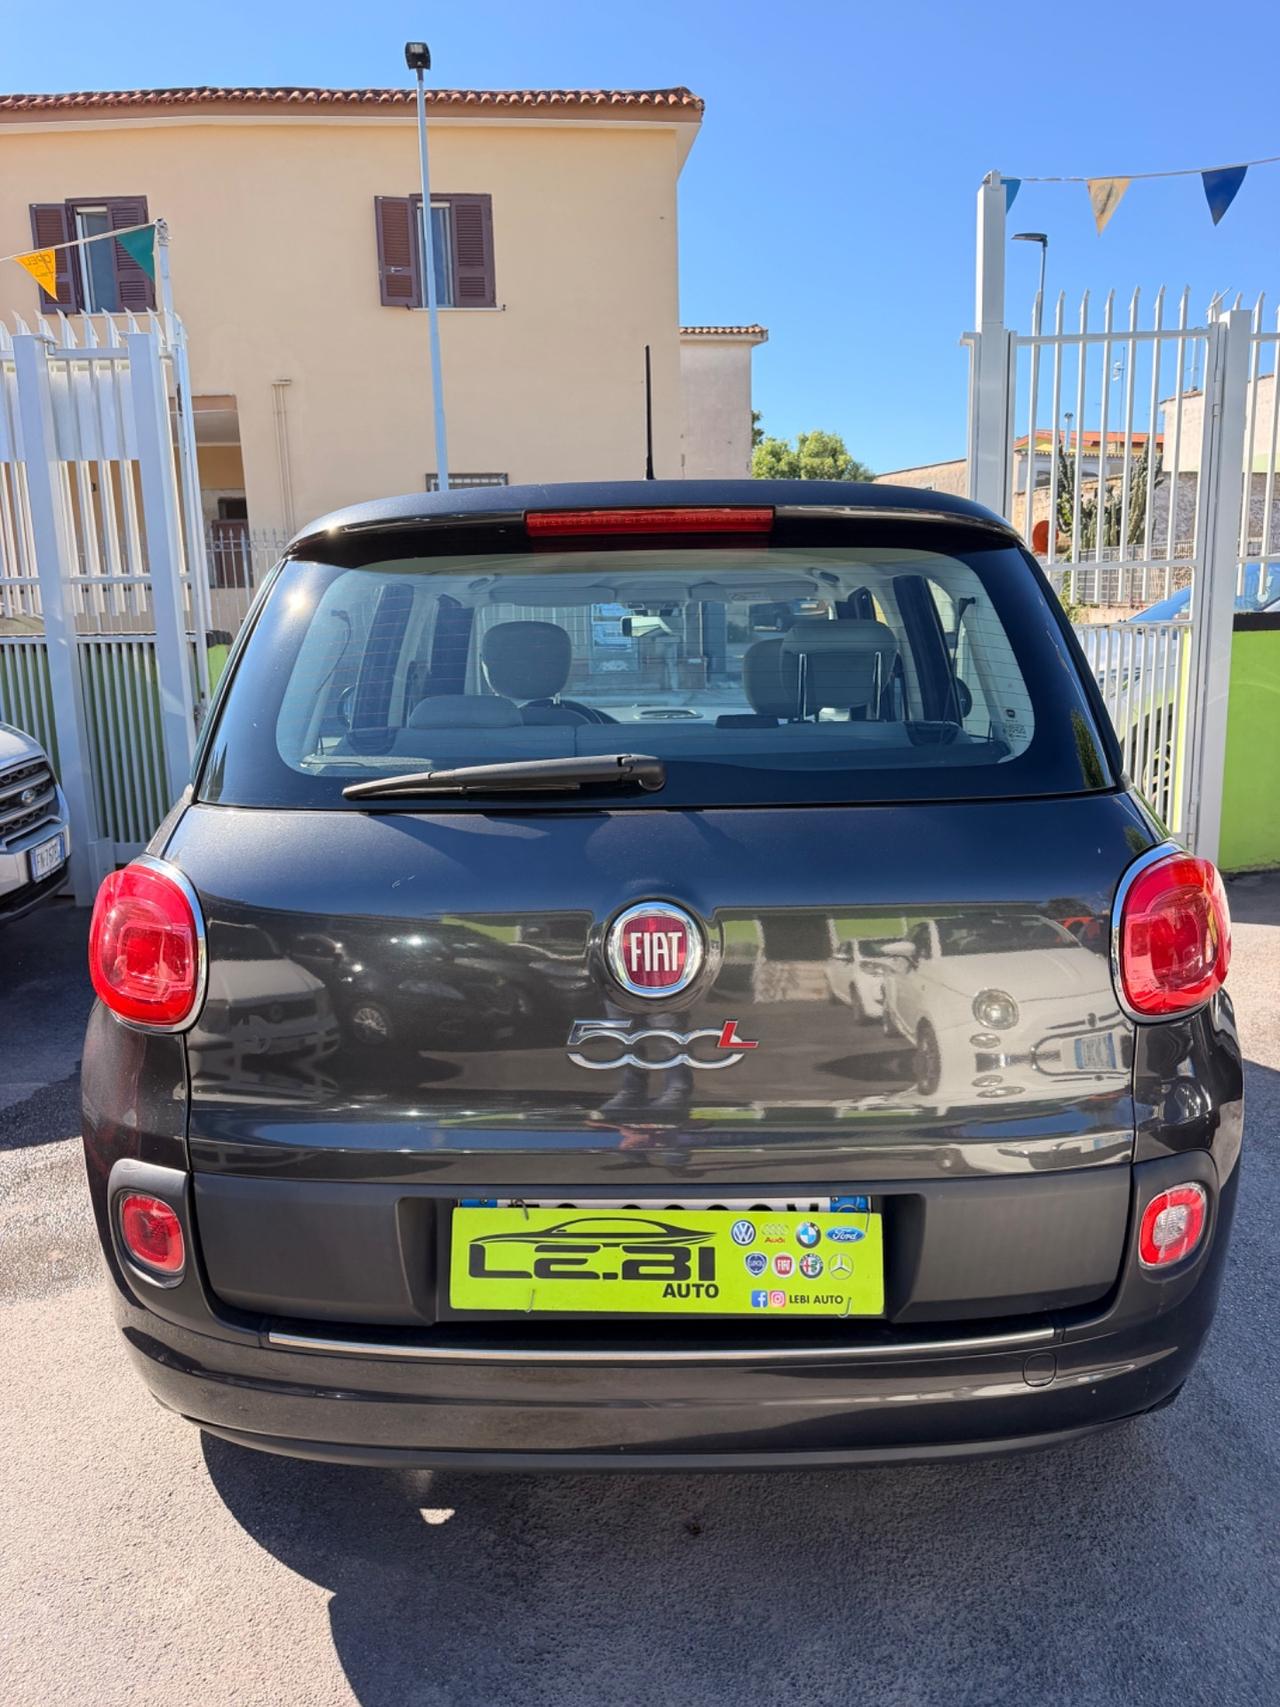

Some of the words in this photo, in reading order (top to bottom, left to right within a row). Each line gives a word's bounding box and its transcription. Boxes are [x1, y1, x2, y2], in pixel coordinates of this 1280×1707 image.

[630, 932, 683, 972] FIAT
[567, 1019, 759, 1070] 500L
[832, 1229, 857, 1241] Ford
[662, 1283, 719, 1298] AUTO
[789, 1294, 810, 1304] LEBI
[813, 1294, 844, 1304] AUTO
